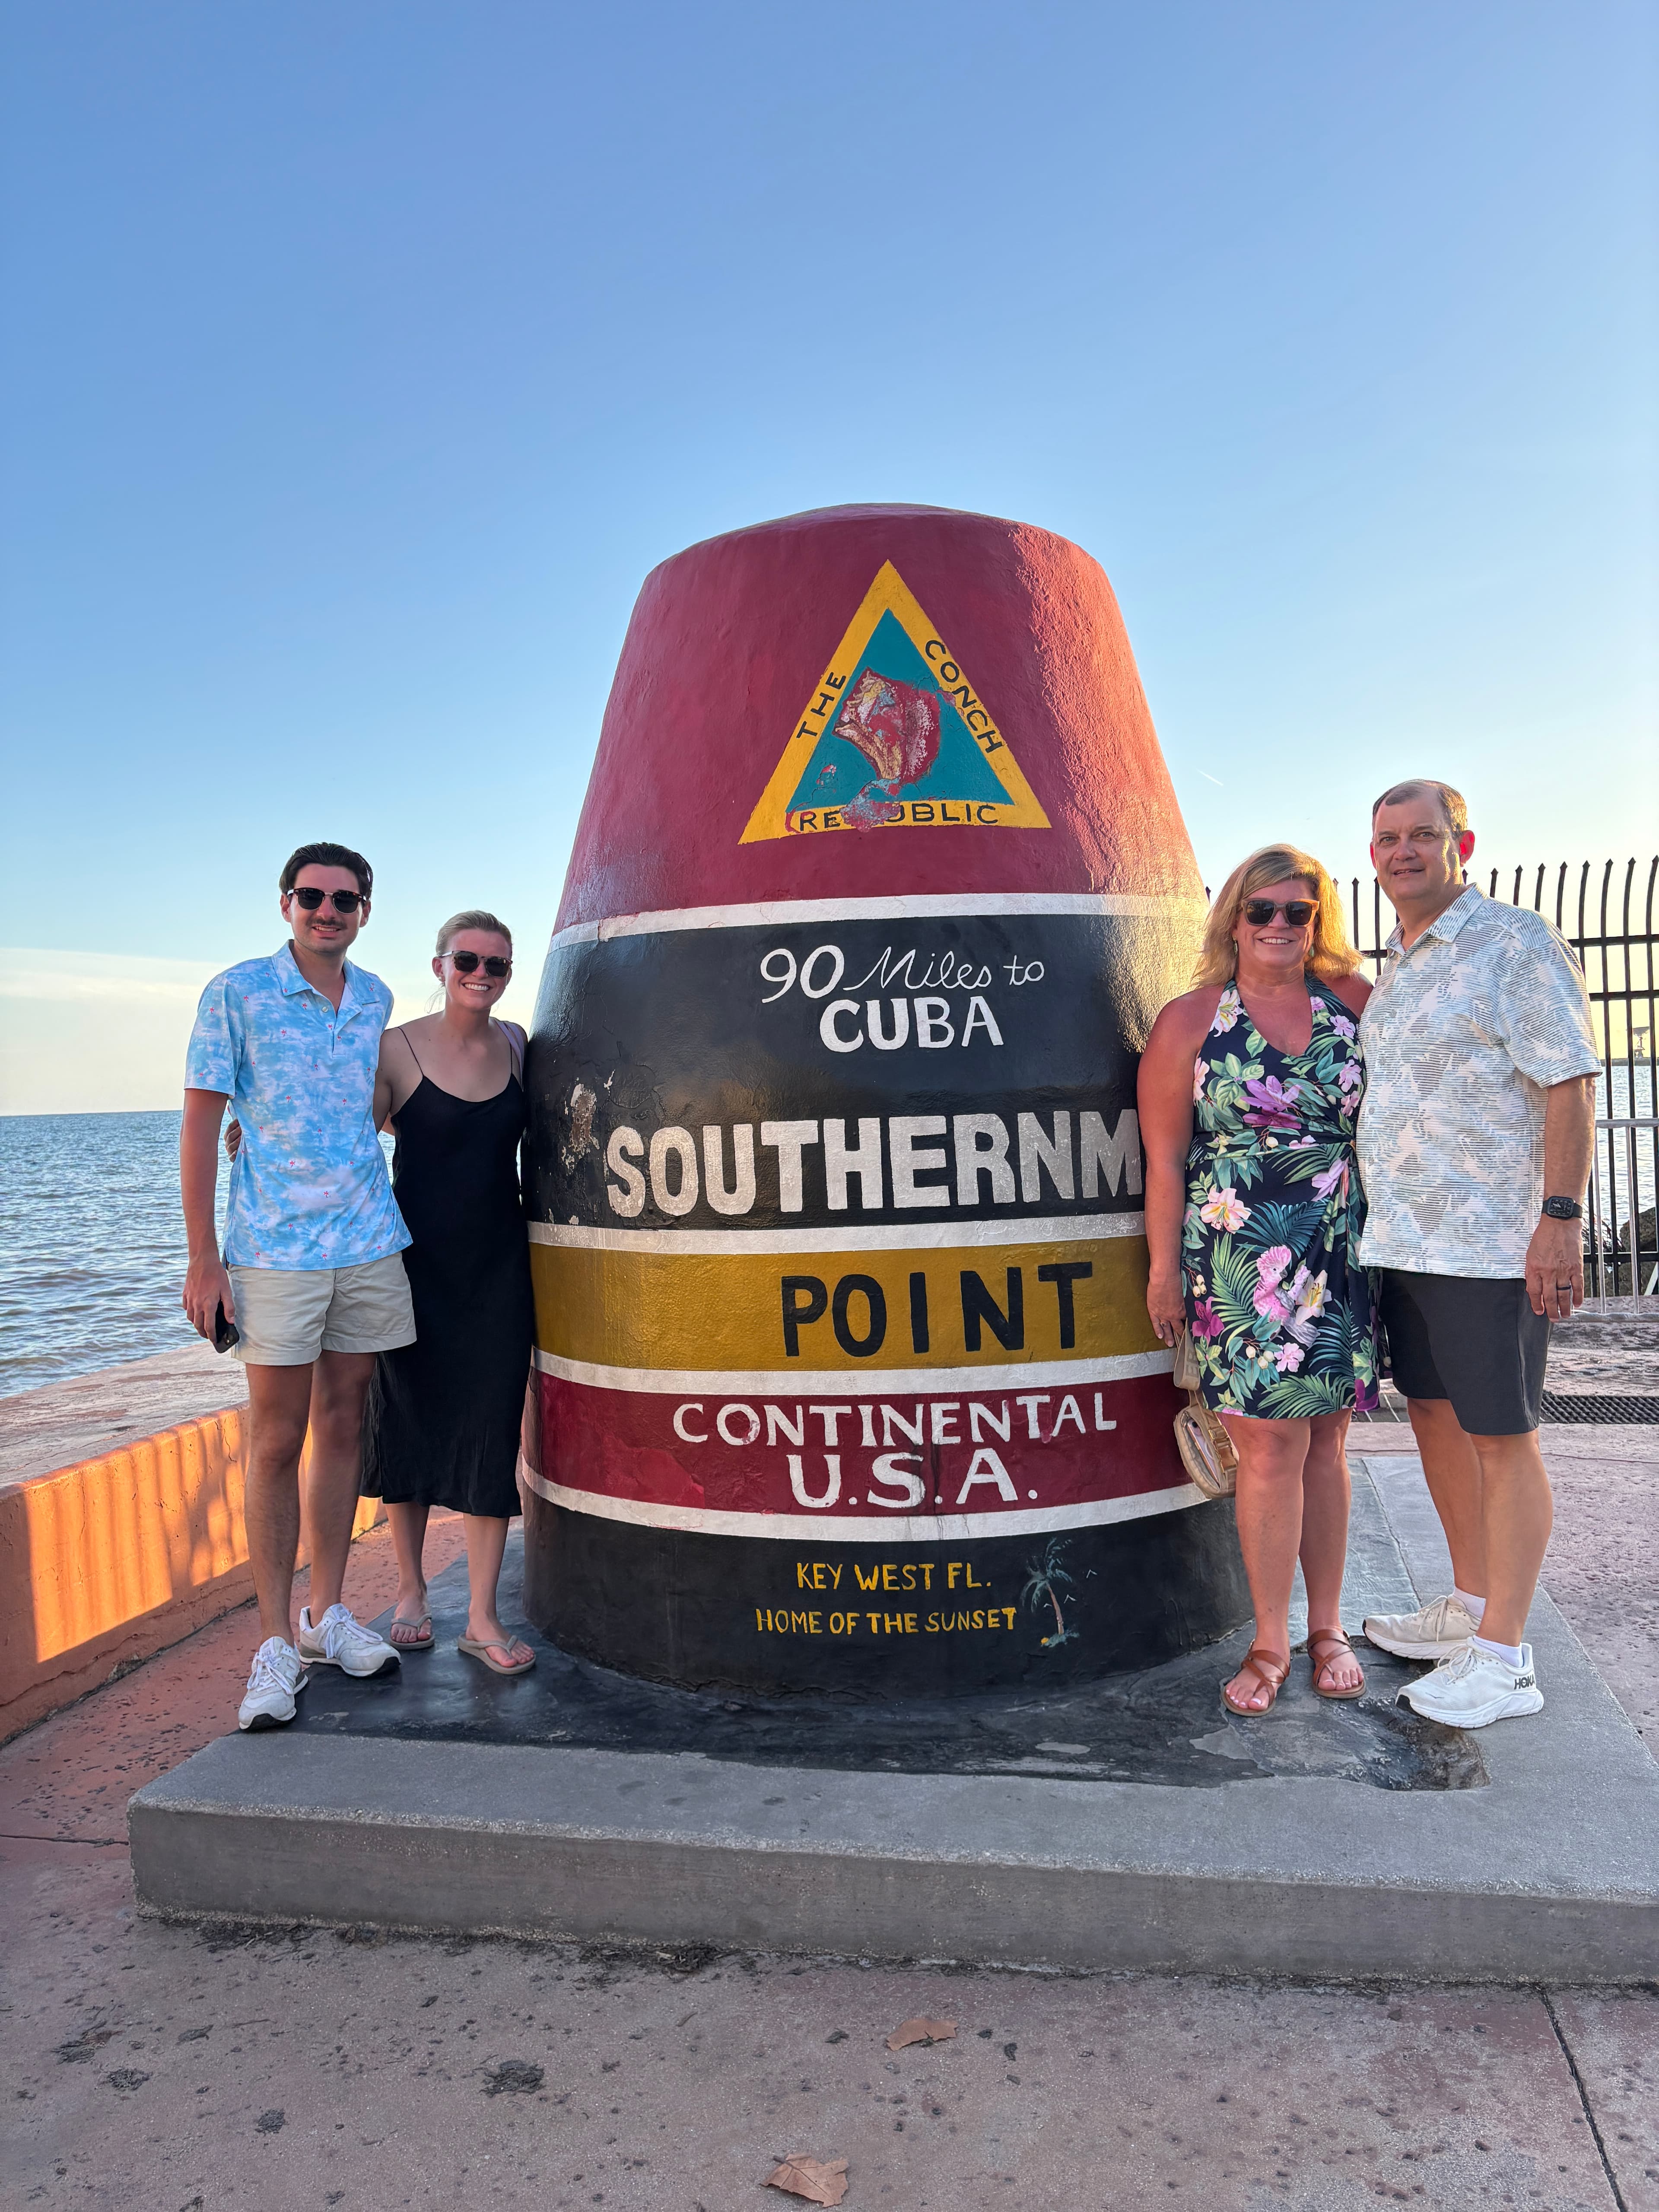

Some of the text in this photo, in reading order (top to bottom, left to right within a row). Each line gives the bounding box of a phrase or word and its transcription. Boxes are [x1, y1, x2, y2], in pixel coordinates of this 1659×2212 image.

[797, 674, 847, 739] THE
[925, 639, 1005, 753] CONCH
[800, 803, 998, 831] REUBLIC
[760, 944, 1045, 1003] 90 Miles to
[820, 995, 1004, 1052] CUBA
[781, 1261, 1093, 1357] POINT
[673, 1392, 1117, 1446] CONTINENTAL
[787, 1447, 1038, 1508] U.S.A.
[797, 1562, 992, 1591] KEY WEST FL.
[756, 1607, 1017, 1635] HOME OF THE SUNSET
[1513, 1674, 1535, 1690] HOKA
